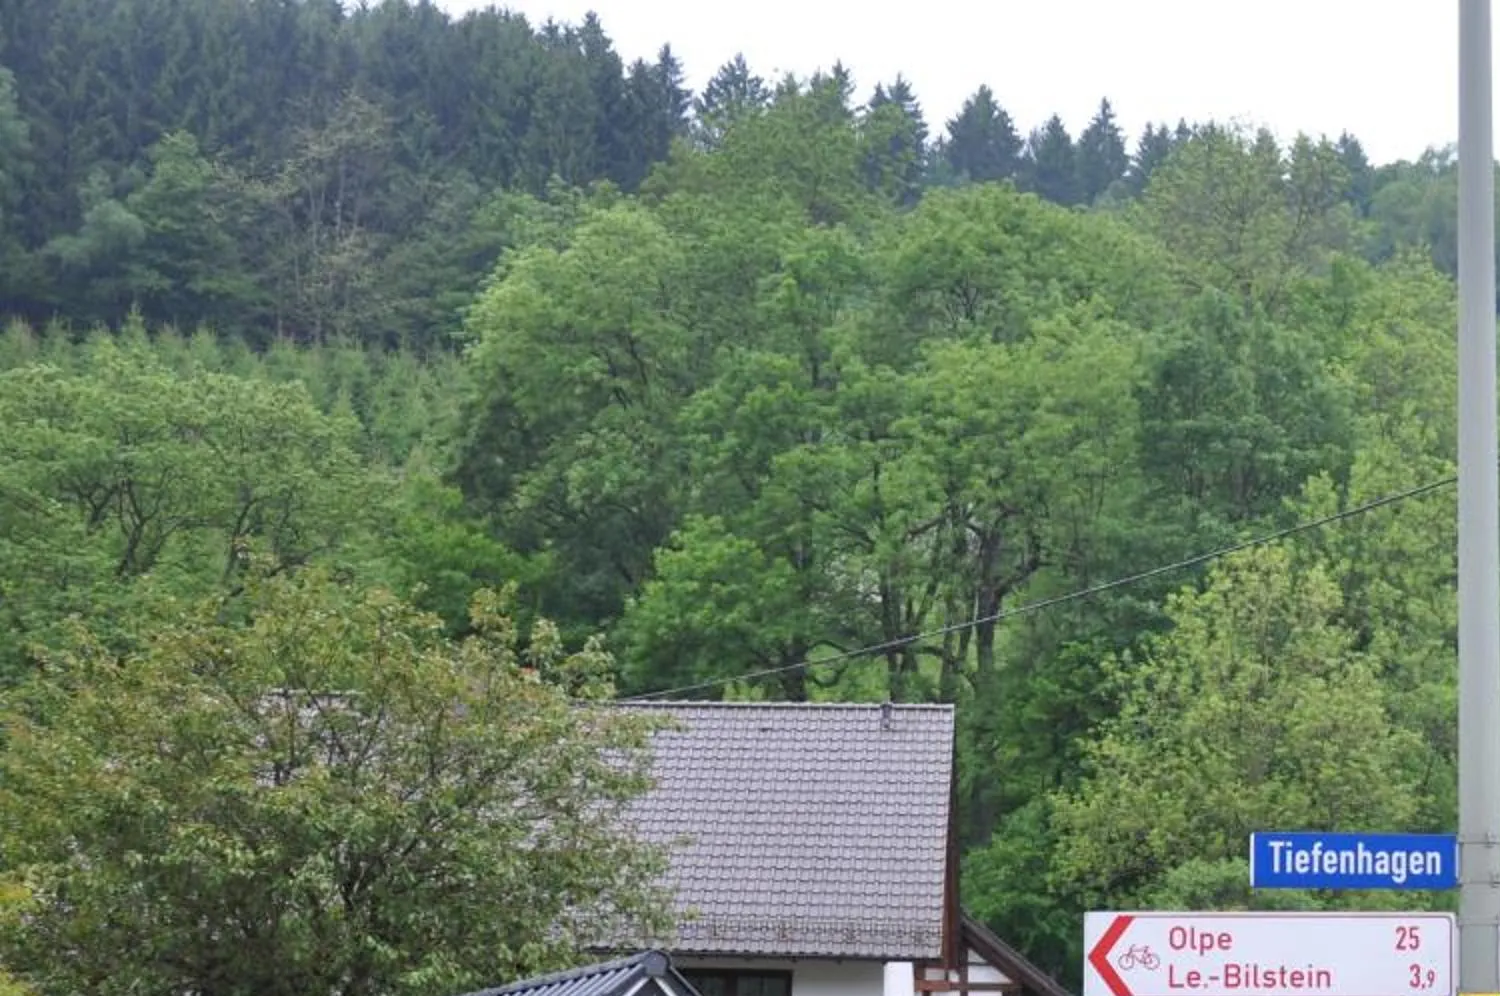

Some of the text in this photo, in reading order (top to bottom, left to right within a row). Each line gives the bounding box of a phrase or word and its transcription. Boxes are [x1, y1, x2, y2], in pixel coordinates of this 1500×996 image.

[1268, 840, 1441, 884] Tiefenhagen
[1168, 926, 1233, 956] Olpe
[1395, 926, 1420, 951] 25
[1168, 964, 1331, 989] Le.-Bilstein
[1409, 964, 1435, 989] 3,9
